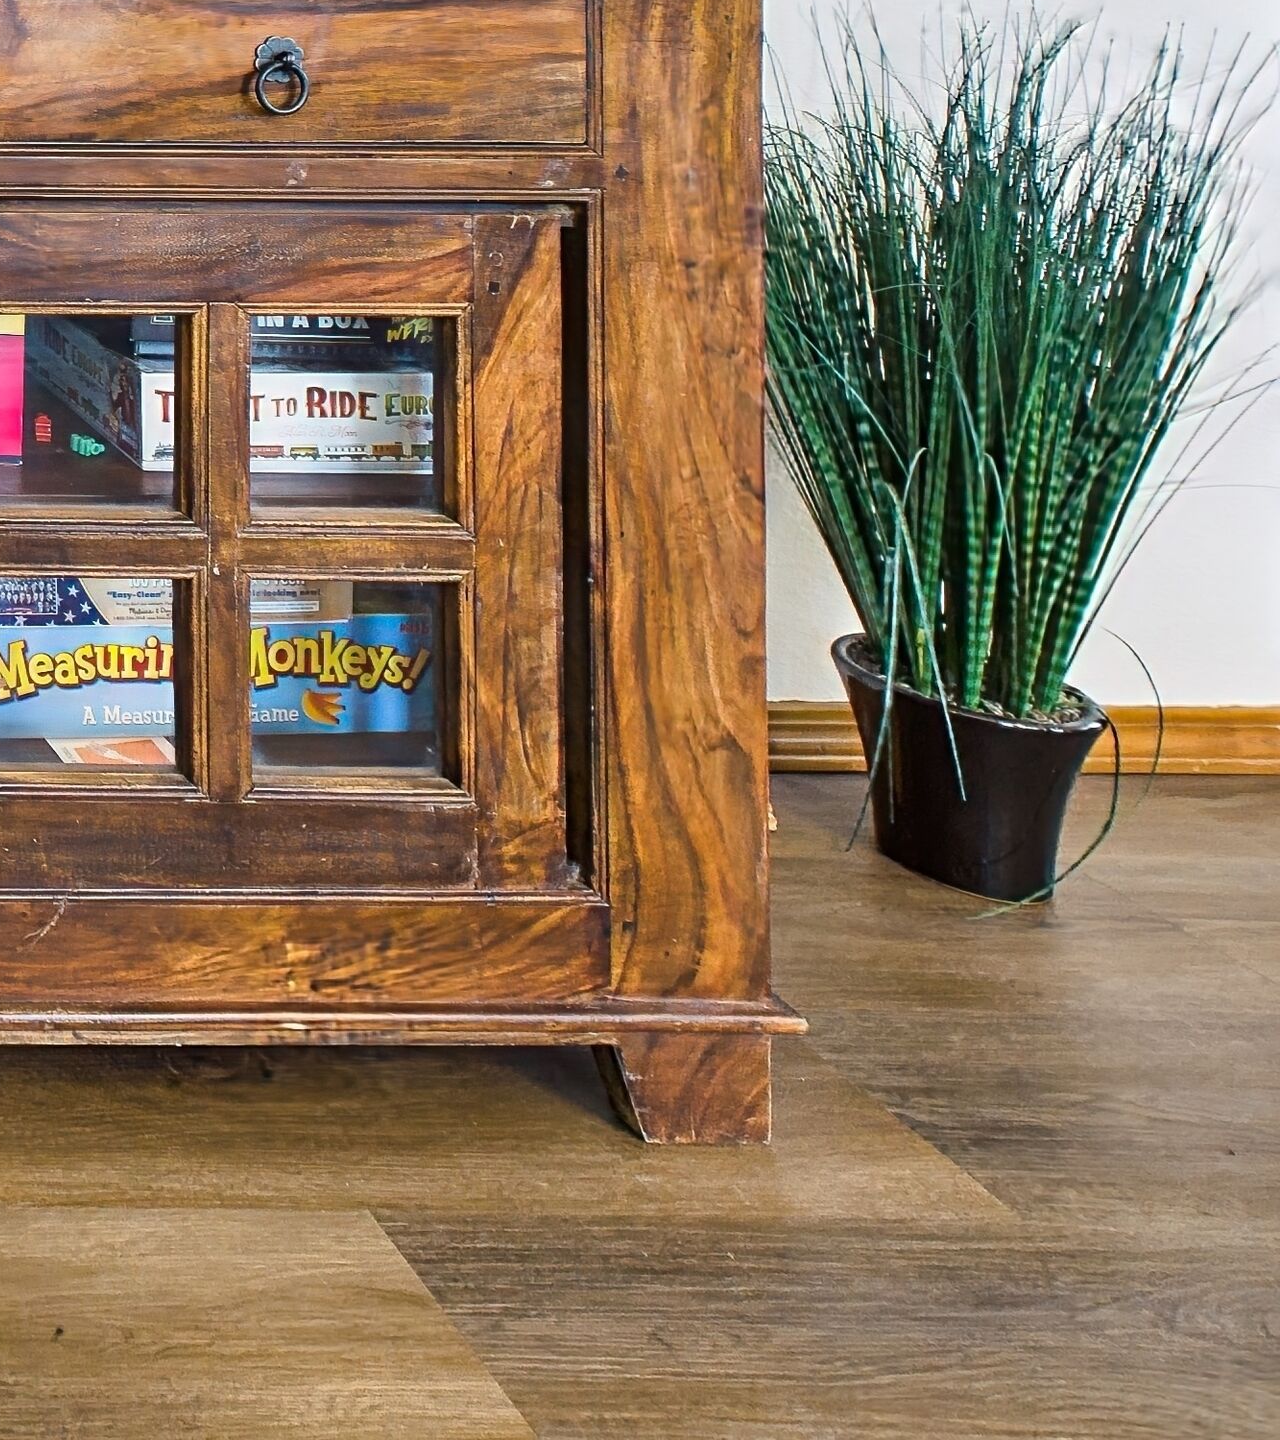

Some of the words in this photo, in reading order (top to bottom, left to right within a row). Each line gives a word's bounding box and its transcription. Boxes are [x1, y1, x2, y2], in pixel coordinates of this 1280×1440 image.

[271, 397, 298, 417] TO
[305, 386, 378, 421] RIDE
[82, 706, 97, 725] A
[103, 704, 174, 725] Measur
